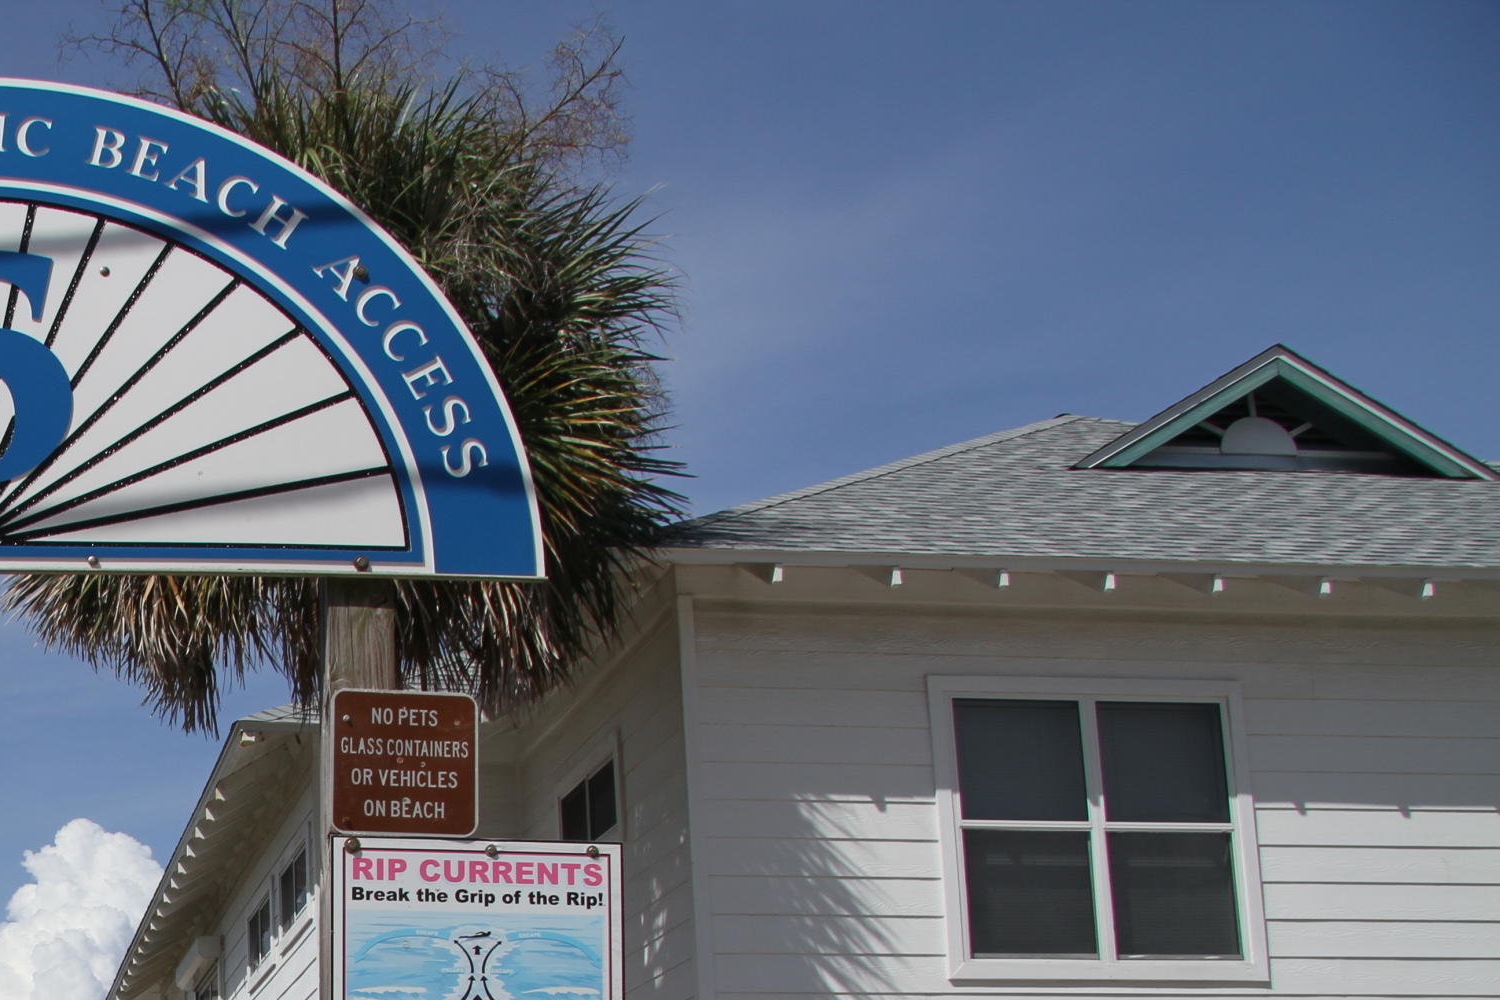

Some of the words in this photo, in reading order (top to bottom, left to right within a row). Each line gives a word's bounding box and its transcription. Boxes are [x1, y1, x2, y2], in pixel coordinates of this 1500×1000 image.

[86, 126, 310, 251] BEACH
[312, 256, 489, 478] ACCESS
[371, 707, 393, 724] NO
[398, 707, 438, 726] PETS
[340, 736, 383, 755] GLASS
[386, 738, 468, 758] CONTAINERS
[351, 767, 373, 785] OR
[378, 769, 458, 788] VEHICLES
[363, 799, 386, 816] ON
[390, 799, 444, 818] BEACH
[352, 856, 407, 880] RIP
[419, 858, 603, 886] CURRENTS
[351, 886, 410, 901] Break
[416, 888, 448, 902] the
[454, 889, 495, 906] Grip
[501, 890, 521, 904] of
[527, 891, 559, 905] the
[566, 891, 603, 909] Rip!
